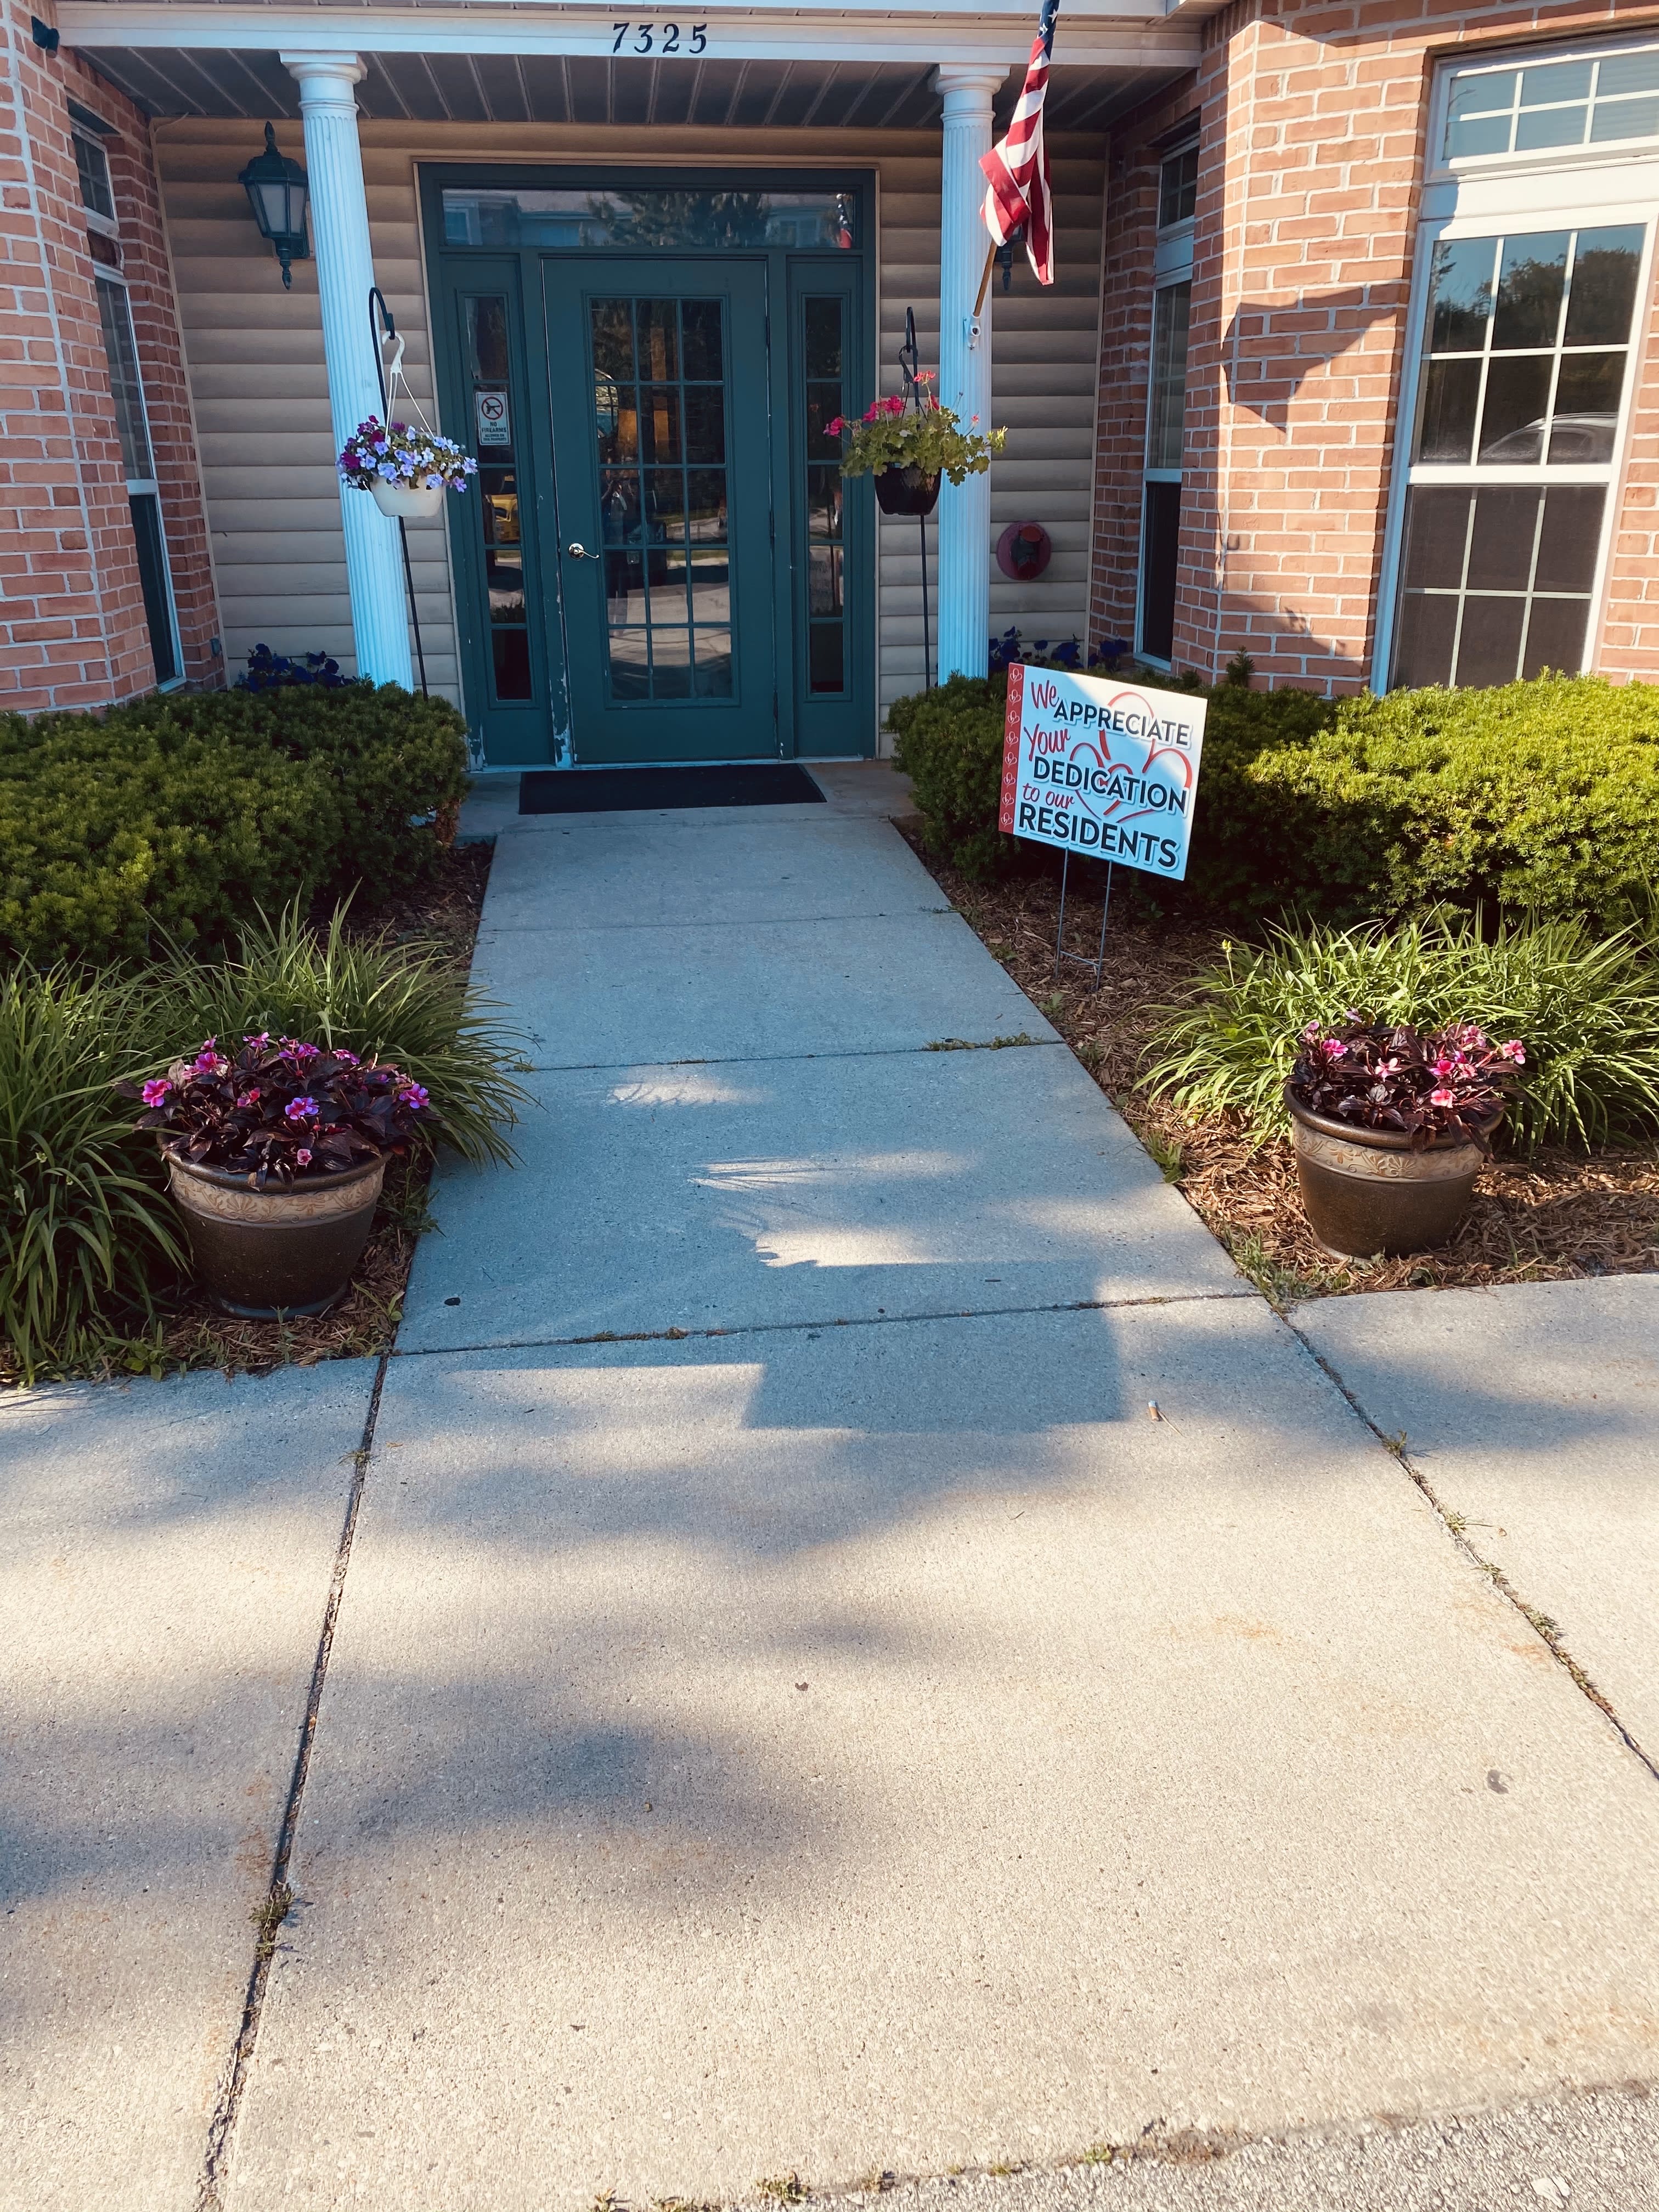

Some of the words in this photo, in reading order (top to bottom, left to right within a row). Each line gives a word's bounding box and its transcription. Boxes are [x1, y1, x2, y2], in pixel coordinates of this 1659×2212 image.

[613, 22, 707, 53] 7325
[1031, 680, 1059, 709] We
[1054, 699, 1189, 746] APPRECIATE
[1023, 783, 1040, 802] to
[1046, 792, 1075, 810] our
[1034, 757, 1187, 814] DEDICATION
[1019, 802, 1177, 868] RESIDENTS
